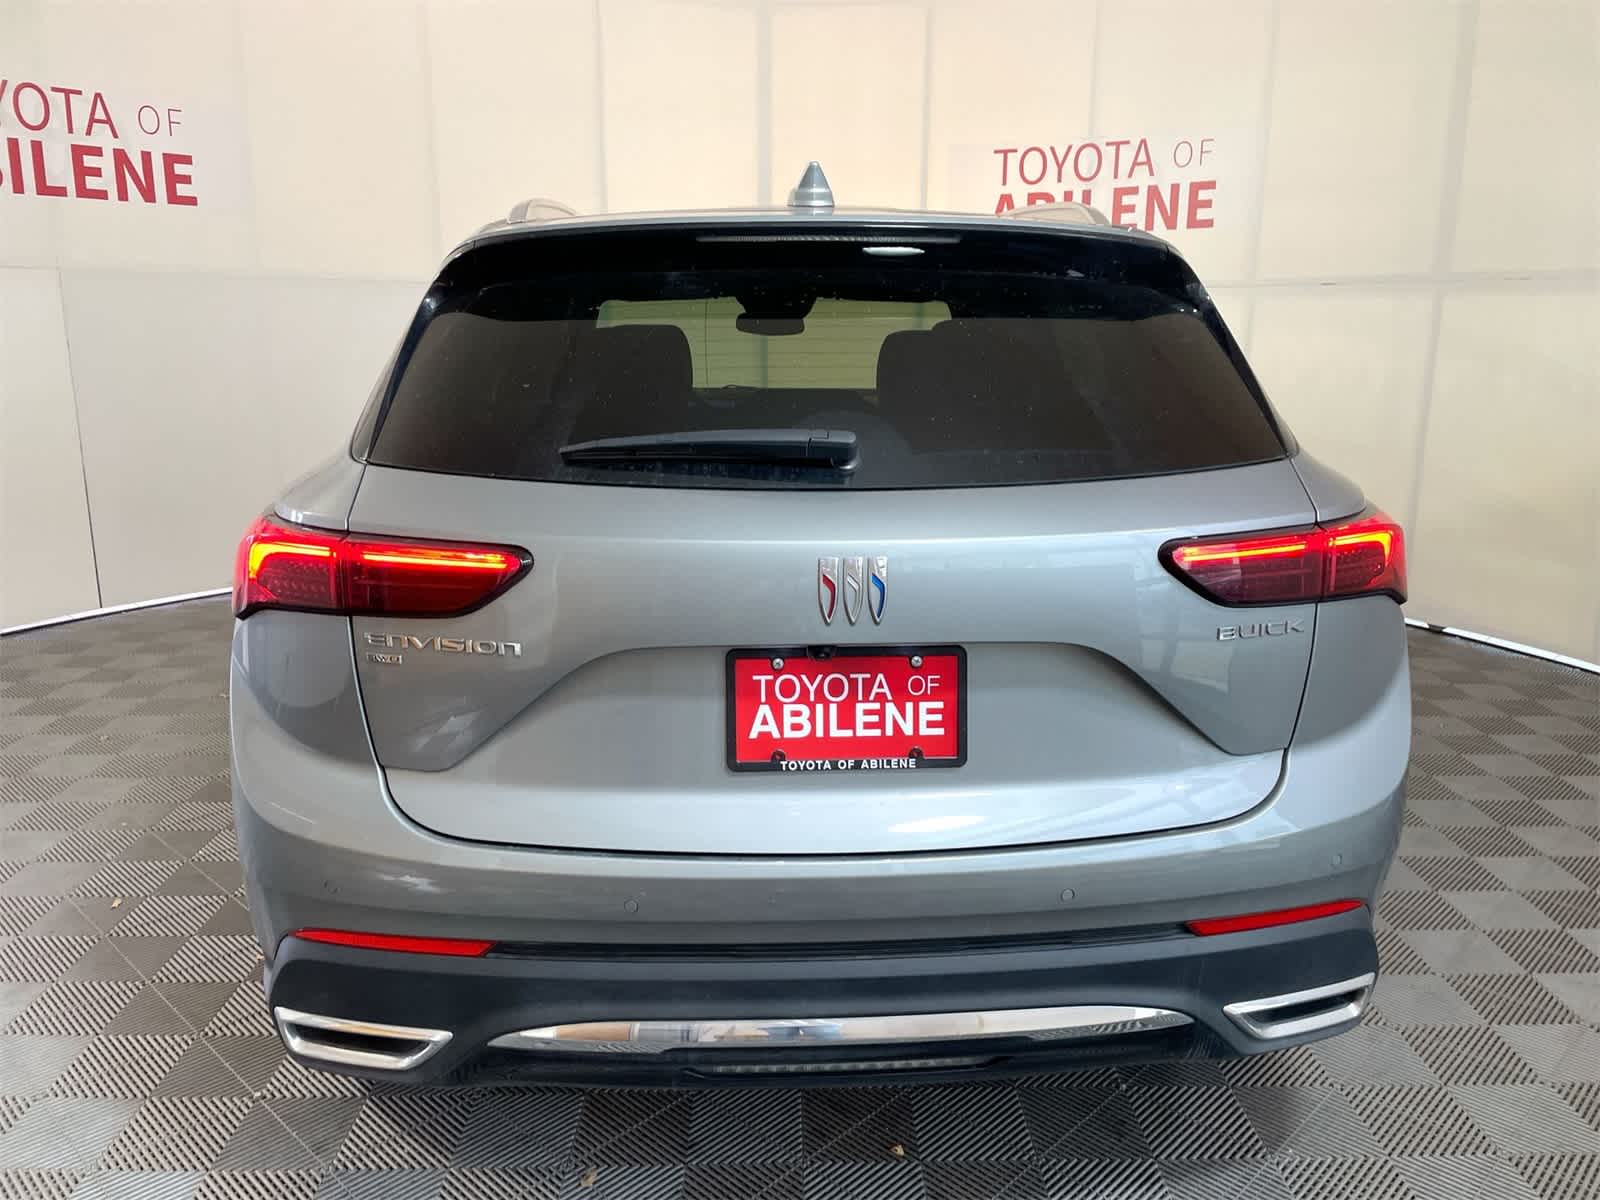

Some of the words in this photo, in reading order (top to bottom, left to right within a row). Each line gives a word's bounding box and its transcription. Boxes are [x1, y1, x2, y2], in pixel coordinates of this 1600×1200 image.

[0, 80, 119, 139] OTA
[138, 105, 182, 137] OF
[0, 137, 198, 206] ILENE
[994, 138, 1155, 186] TOYOTA
[1173, 139, 1215, 168] OF
[1216, 619, 1304, 641] BUICK
[752, 673, 892, 703] TOYOTA
[908, 674, 941, 696] OF
[748, 701, 945, 739] ABILENE
[780, 759, 832, 771] TOYOTA
[837, 759, 855, 770] OF
[860, 758, 917, 769] ABILENE
